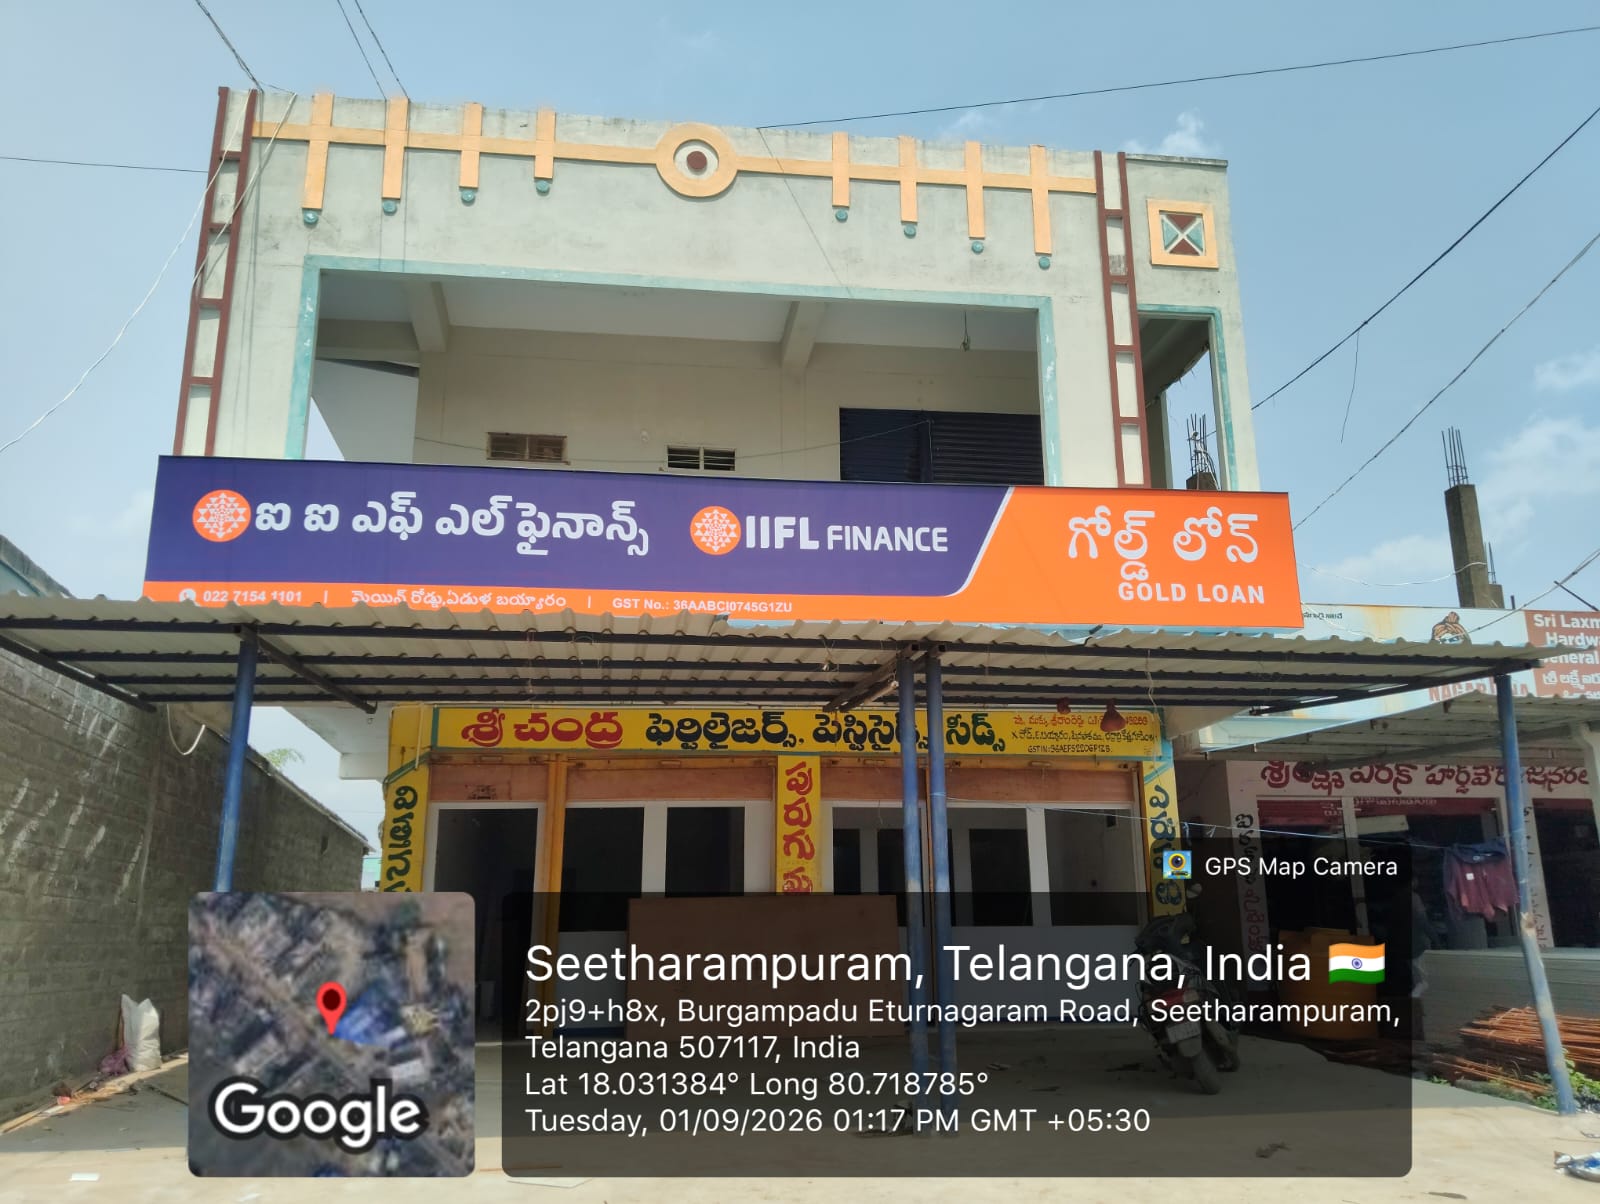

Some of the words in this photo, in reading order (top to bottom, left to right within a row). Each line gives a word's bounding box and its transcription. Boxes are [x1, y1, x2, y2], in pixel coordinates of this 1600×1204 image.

[256, 503, 290, 530] ఐ
[305, 504, 340, 532] ఐ
[353, 492, 423, 540] ఎఫ్
[435, 496, 513, 537] ఎల్
[516, 500, 649, 556] ఫైనాన్స్
[746, 515, 820, 550] IIFL
[828, 525, 948, 552] FINANCE
[1069, 505, 1155, 581] గోల్డ్
[1174, 506, 1258, 563] లోన్
[203, 590, 229, 602] 022
[232, 591, 267, 603] 7154
[271, 591, 302, 603] 1101
[612, 597, 640, 609] GST
[644, 598, 670, 611] No.:
[1118, 581, 1186, 603] GOLD
[1197, 583, 1265, 604] LOAN
[1533, 613, 1556, 627] Sri
[1544, 650, 1599, 665] eneral
[462, 708, 504, 748] శ్రీ
[514, 711, 624, 749] చంద్ర
